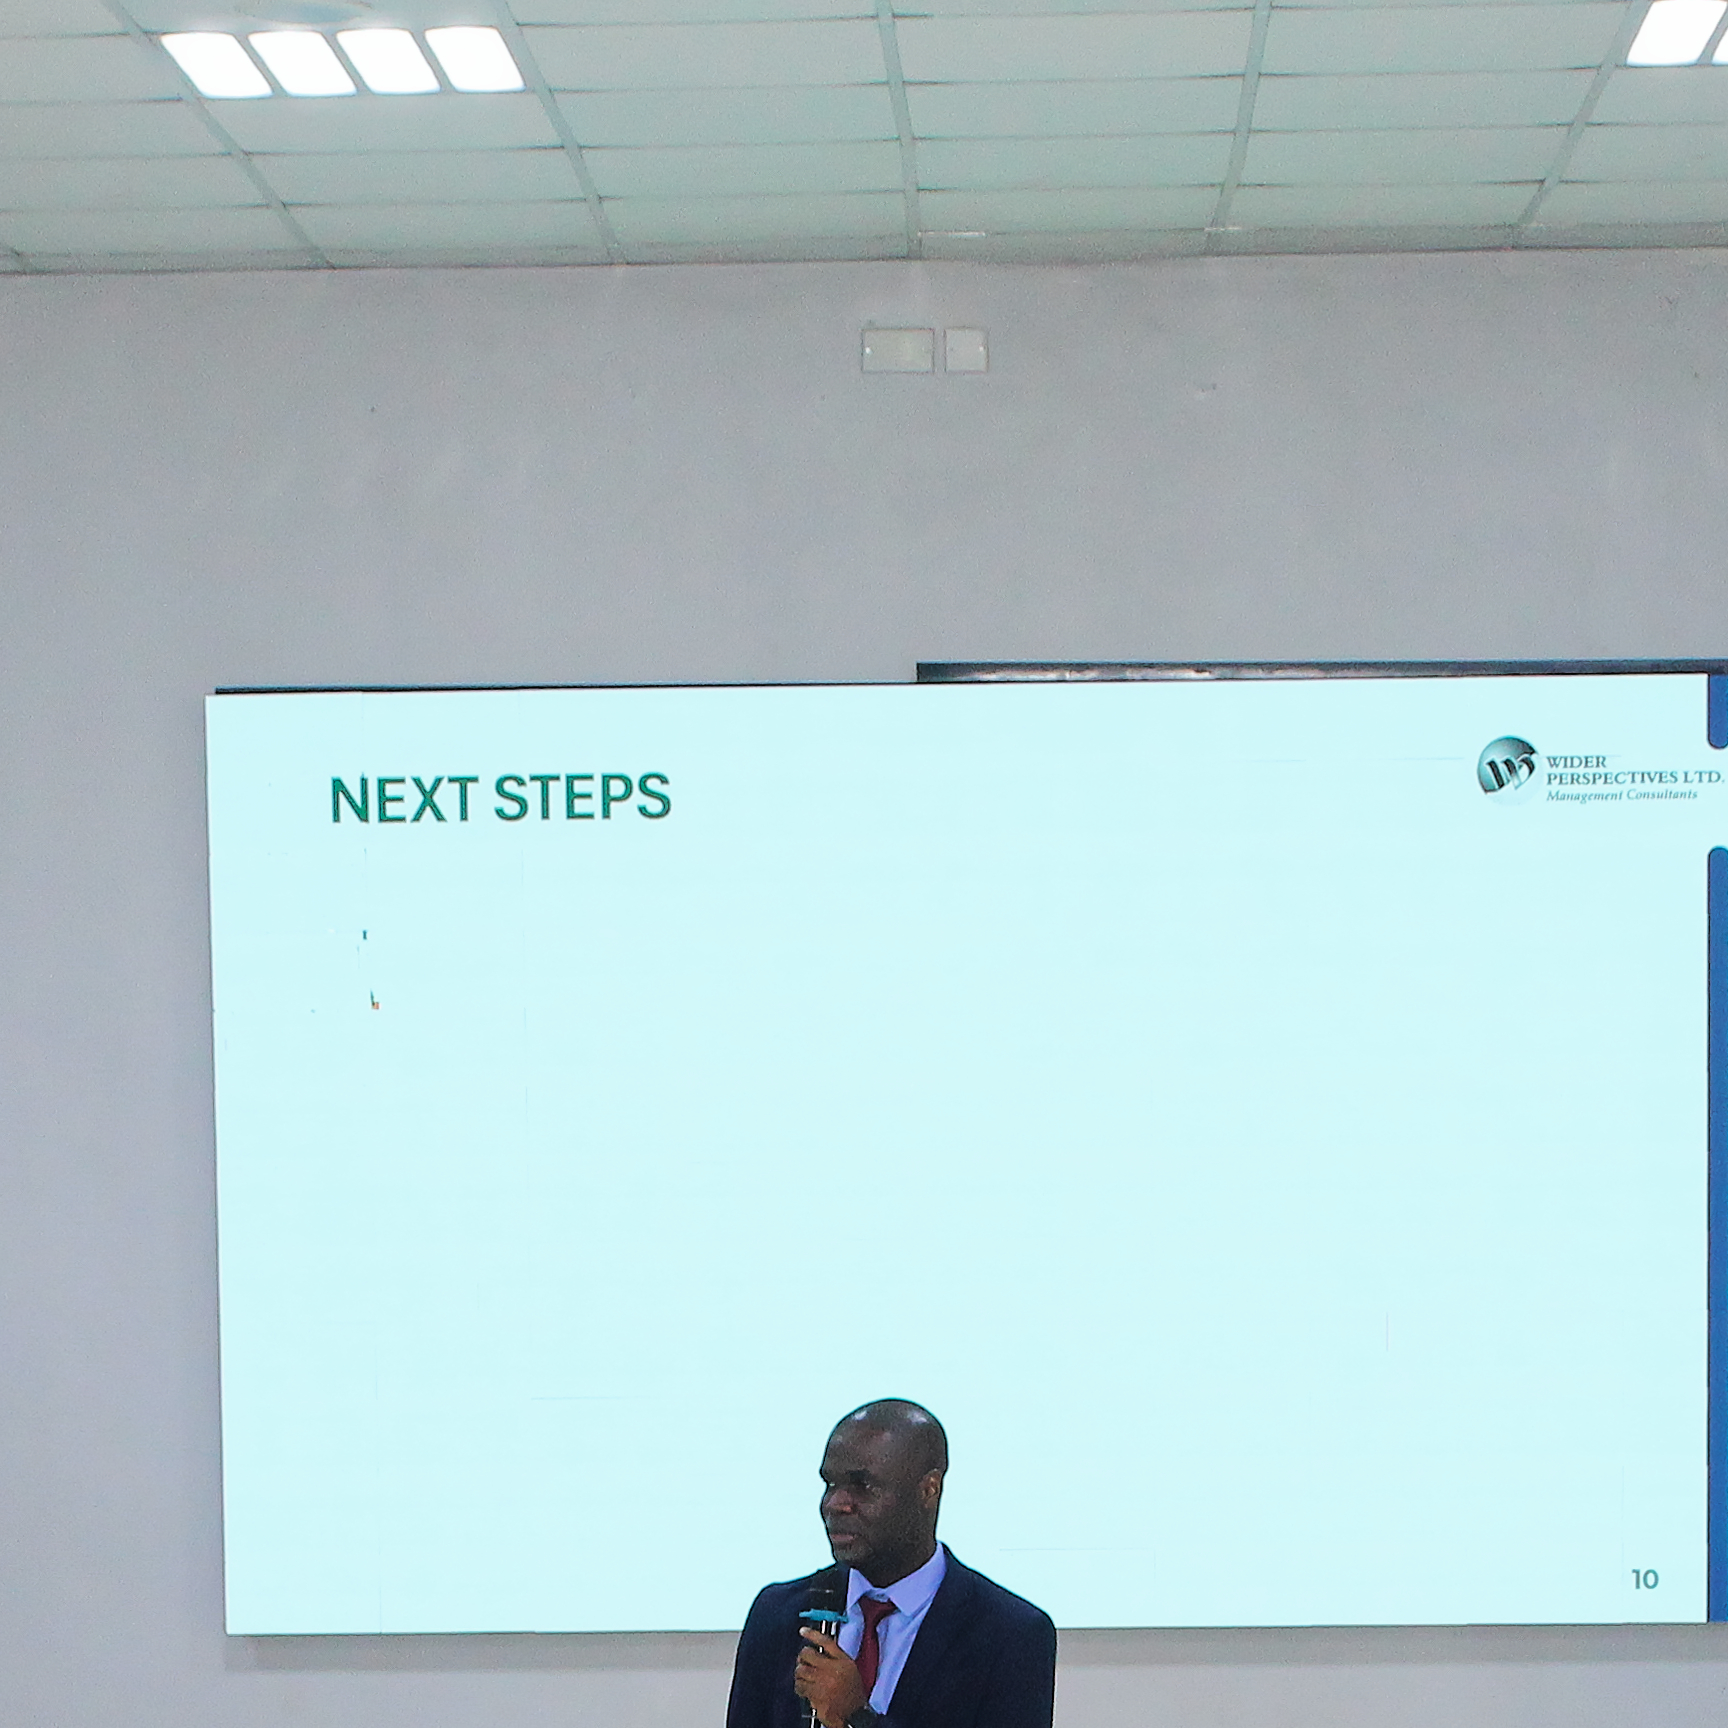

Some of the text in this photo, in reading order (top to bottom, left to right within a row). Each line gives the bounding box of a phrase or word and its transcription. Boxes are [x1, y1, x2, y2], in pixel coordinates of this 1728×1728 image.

[1546, 755, 1607, 769] WIDER
[1546, 770, 1725, 786] PERSPECTIVES LTD.
[331, 771, 672, 824] NEXT STEPS
[1546, 787, 1698, 805] Management Consultants
[1631, 1568, 1660, 1590] 10
